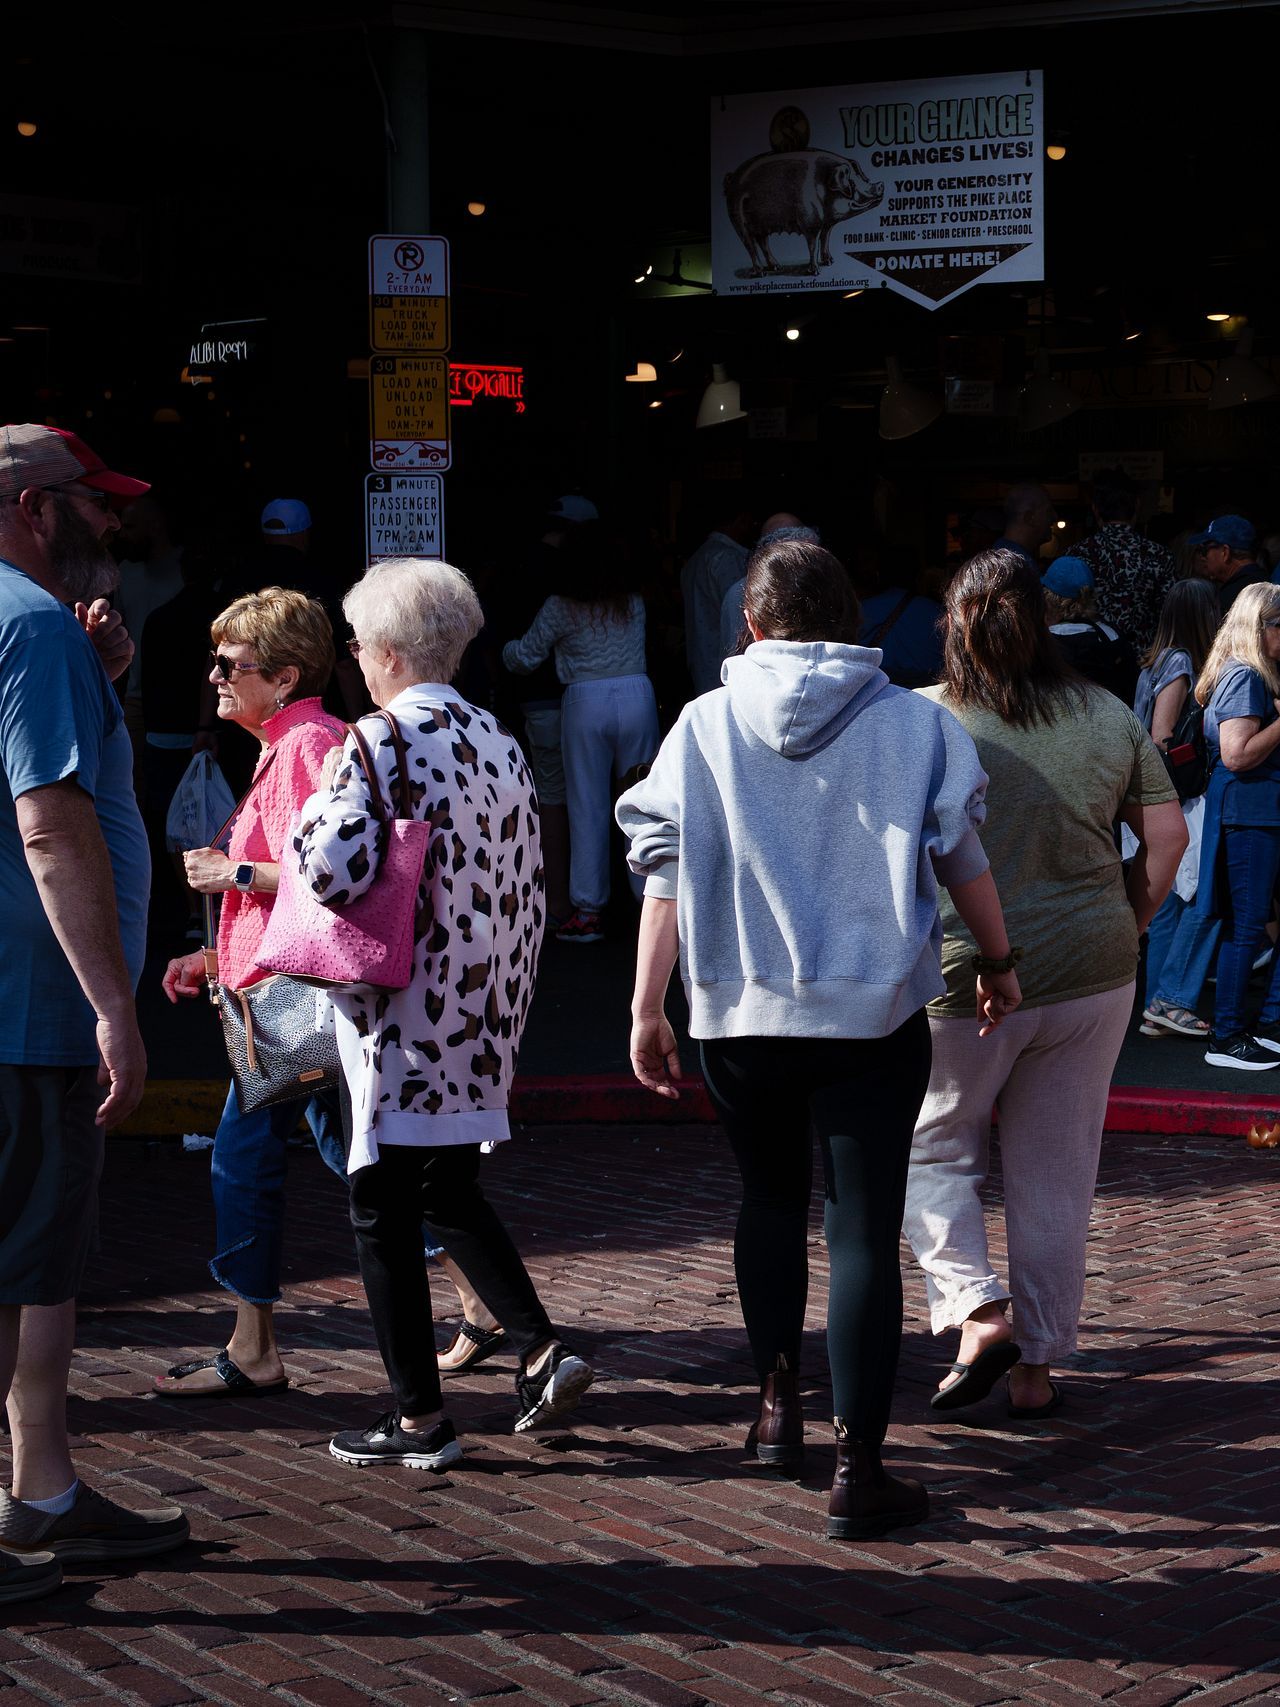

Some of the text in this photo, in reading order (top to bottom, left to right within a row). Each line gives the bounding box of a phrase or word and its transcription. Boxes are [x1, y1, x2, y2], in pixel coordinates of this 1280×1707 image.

[839, 93, 1034, 148] YOUR CHANGE
[871, 141, 1033, 167] CHANGES LIVES!
[894, 172, 1033, 193] YOUR GENEROSITY
[888, 190, 1033, 211] SUPPORTS THE PIKE PLACE
[879, 207, 1033, 227] MARKET FOUNDATION
[844, 225, 1033, 244] FOOD BANK CLINIC SENIOR CENTER PRESCHOOL
[875, 251, 1001, 271] DONATE HERE!
[386, 272, 432, 284] 2-7 AM
[388, 285, 431, 294] EVERYDAY
[729, 278, 870, 293] www.pikeplacemarketfoundation.org
[375, 296, 440, 308] 30 MINUTE
[392, 310, 428, 320] TRUCK
[381, 321, 437, 331] LOAD ONLY
[190, 340, 216, 364] ALIBI
[375, 360, 442, 372] 30 MINUTE
[382, 377, 438, 389] LOAD AND
[465, 370, 525, 399] PIGALLE
[386, 391, 433, 402] UNLOAD
[395, 405, 425, 417] ONLY
[387, 420, 434, 430] 10AM-7PM
[375, 477, 437, 490] 3 MINUTE
[372, 496, 437, 511] PASSENGER
[372, 512, 437, 526] LOAD ONLY
